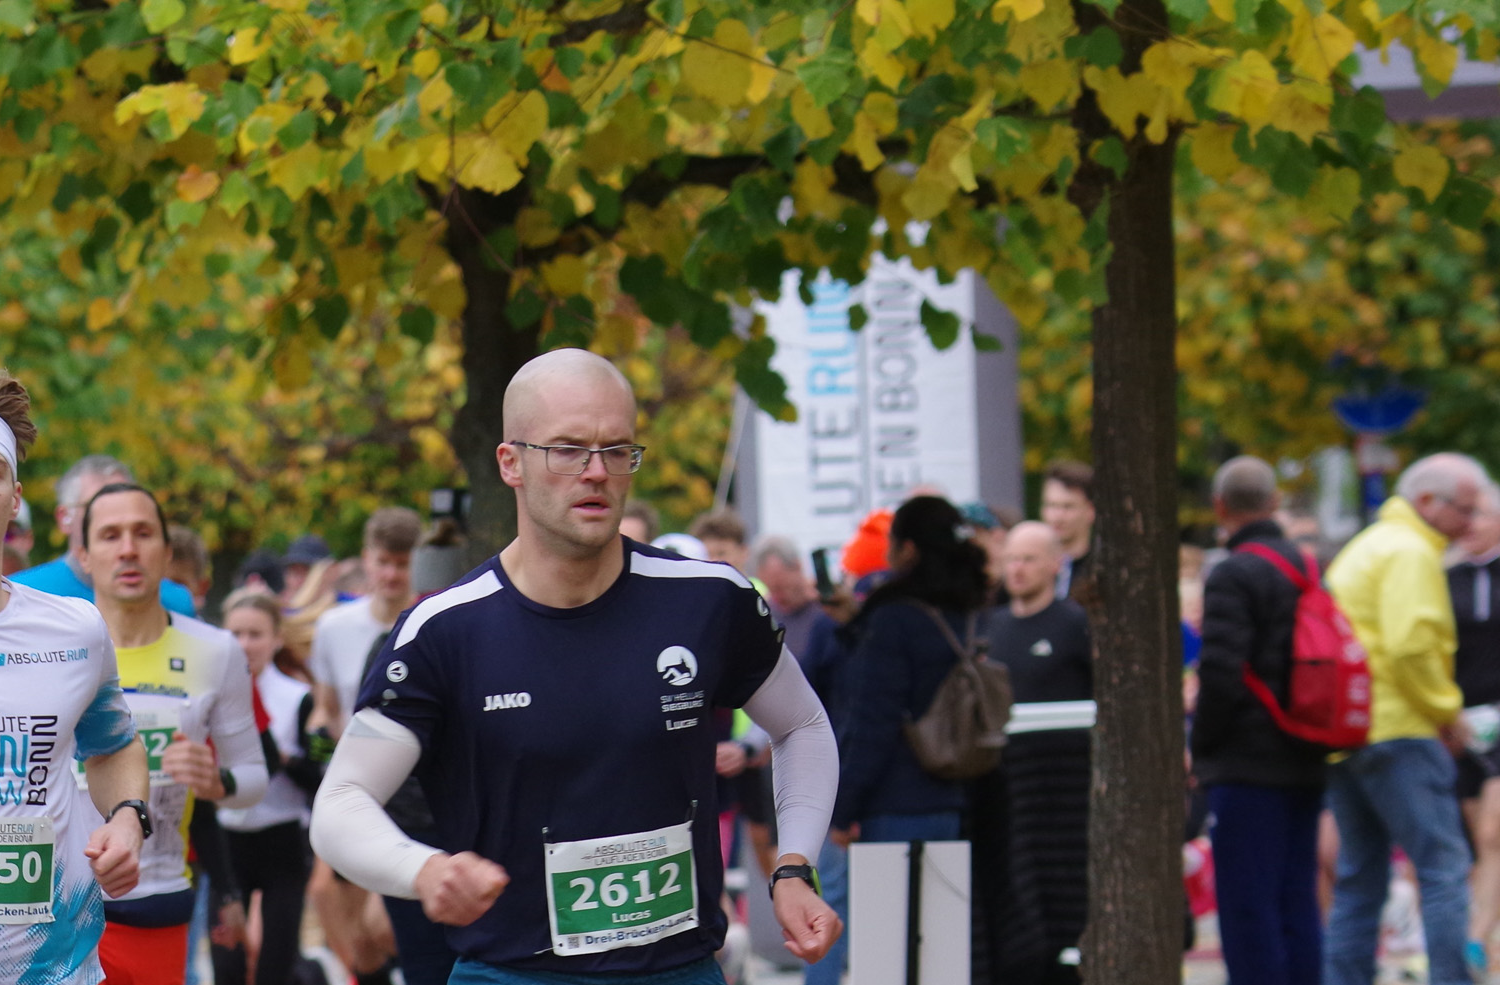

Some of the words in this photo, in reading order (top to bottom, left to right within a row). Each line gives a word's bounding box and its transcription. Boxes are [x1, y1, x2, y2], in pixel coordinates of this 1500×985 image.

[873, 278, 920, 412] BONN
[483, 692, 532, 711] JAKO
[26, 715, 58, 806] BONN
[569, 862, 682, 912] 2612
[584, 913, 692, 945] Drei-Brücken-Lauf
[612, 910, 652, 924] Lucas
